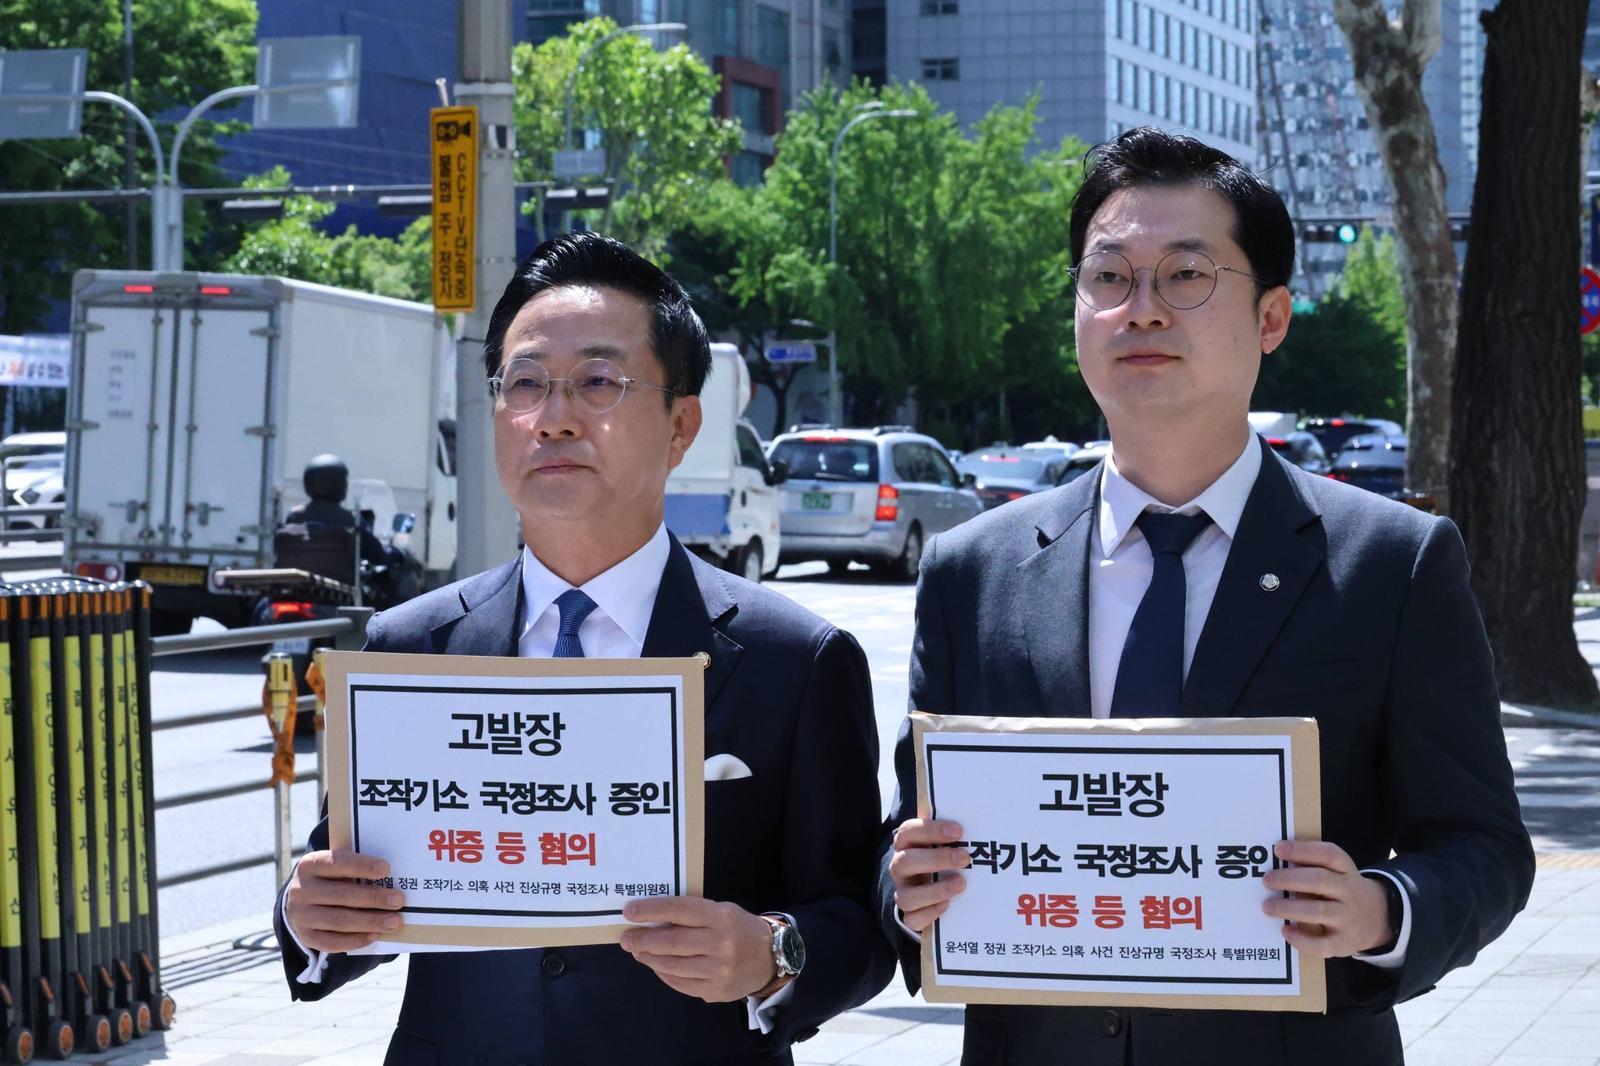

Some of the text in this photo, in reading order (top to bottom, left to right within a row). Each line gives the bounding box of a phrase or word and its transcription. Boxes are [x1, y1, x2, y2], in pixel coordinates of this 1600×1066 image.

[448, 711, 566, 757] 고발장
[359, 777, 671, 816] 조작기소 국정조사 증인
[1039, 772, 1169, 818] 고발장
[428, 828, 597, 866] 위증 등 혐의
[942, 840, 1280, 879] 작기소 국정조사 증인
[398, 877, 418, 890] 정권
[423, 879, 464, 892] 조작기소
[468, 880, 489, 893] 의혹
[494, 881, 515, 893] 사건
[519, 881, 561, 895] 진상규명
[566, 882, 609, 896] 국정조사
[613, 883, 670, 897] 특별위원회
[1016, 892, 1203, 931] 위증 등 혐의
[945, 941, 1281, 961] 윤석열 정권 조작기소 의혹 사건 진상규명 국정조사 특별위원회
